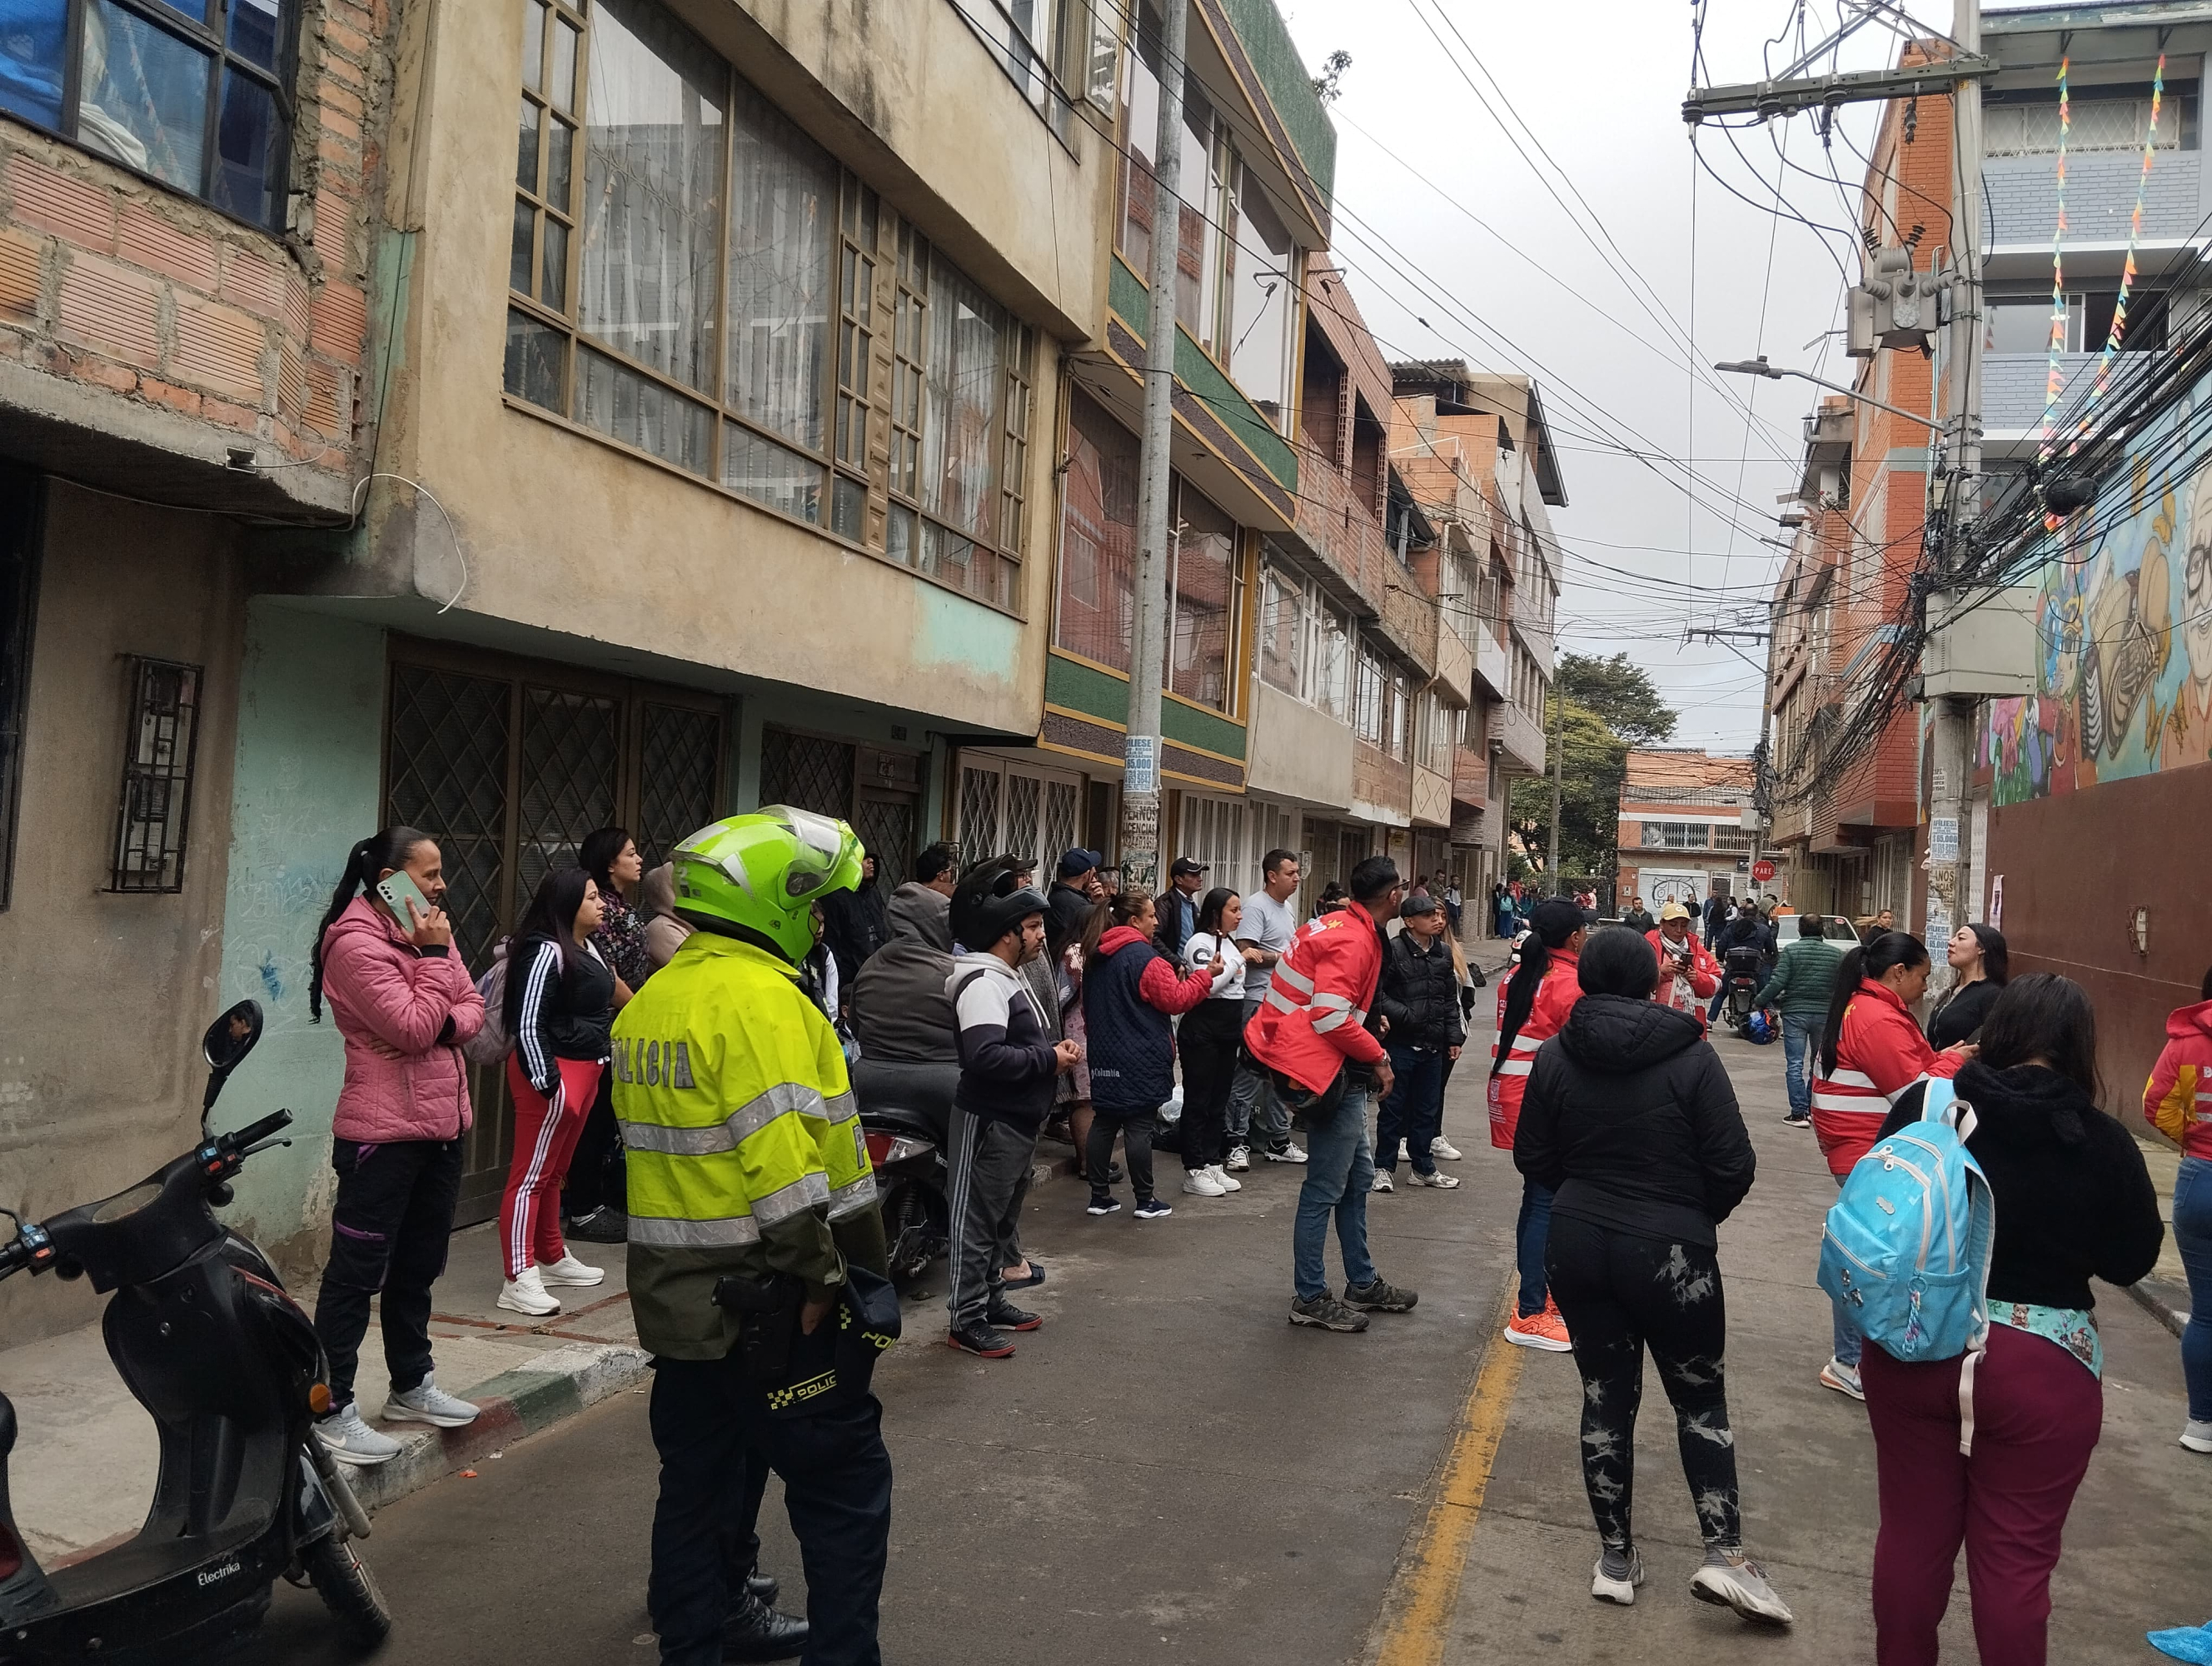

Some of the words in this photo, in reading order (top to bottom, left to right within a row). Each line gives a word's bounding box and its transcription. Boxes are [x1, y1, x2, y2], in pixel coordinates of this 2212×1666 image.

[1935, 870, 1954, 881] ANOS
[1094, 1068, 1120, 1078] Columbia
[197, 1562, 241, 1586] Electrika
